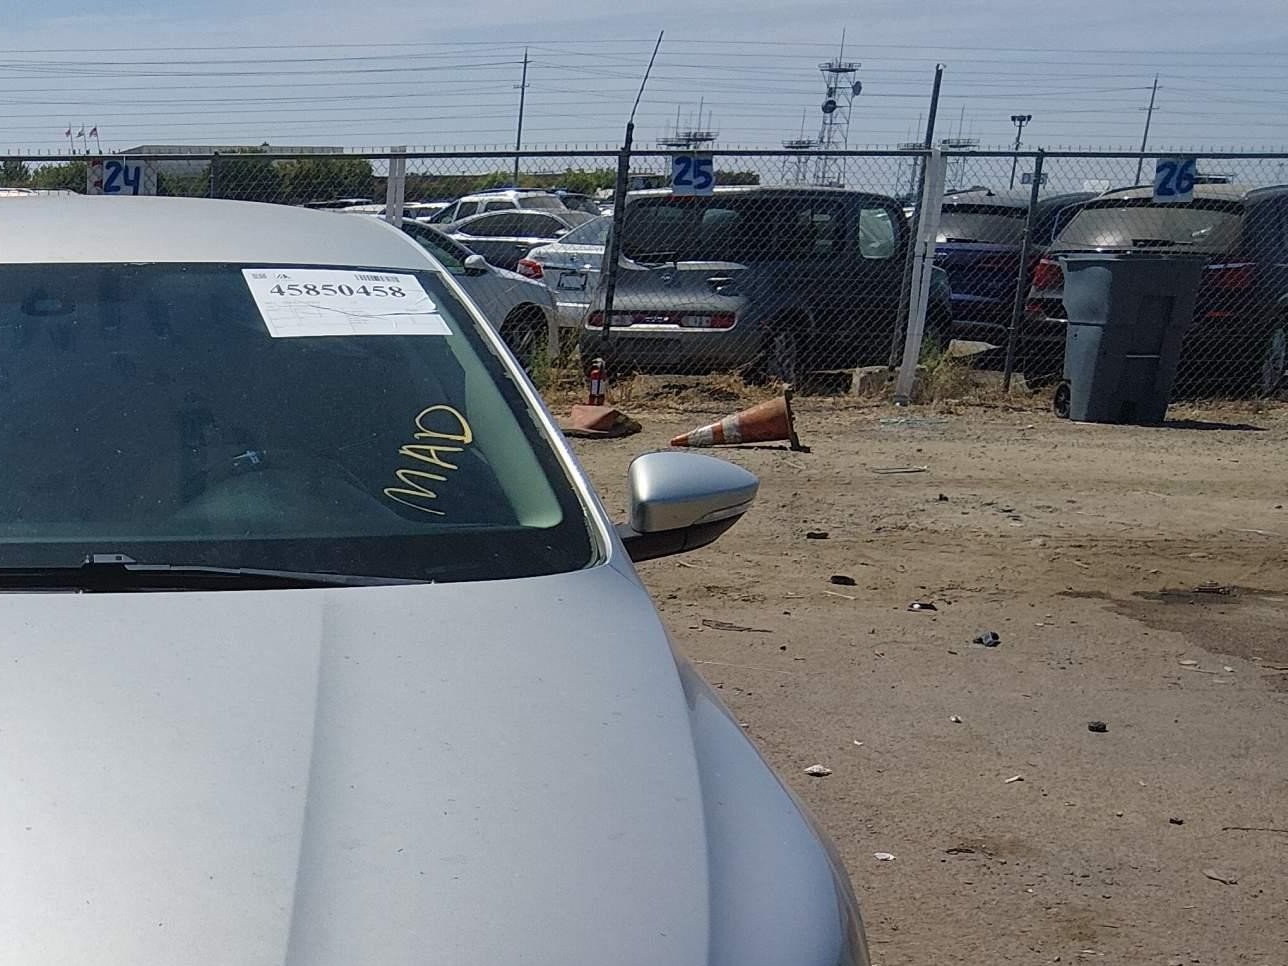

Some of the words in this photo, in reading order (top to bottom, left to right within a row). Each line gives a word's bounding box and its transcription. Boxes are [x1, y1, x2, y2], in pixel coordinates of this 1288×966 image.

[103, 160, 141, 195] 24
[673, 155, 713, 190] 25
[1155, 160, 1194, 196] 26
[270, 283, 407, 298] 45850458
[383, 404, 473, 516] MAD
